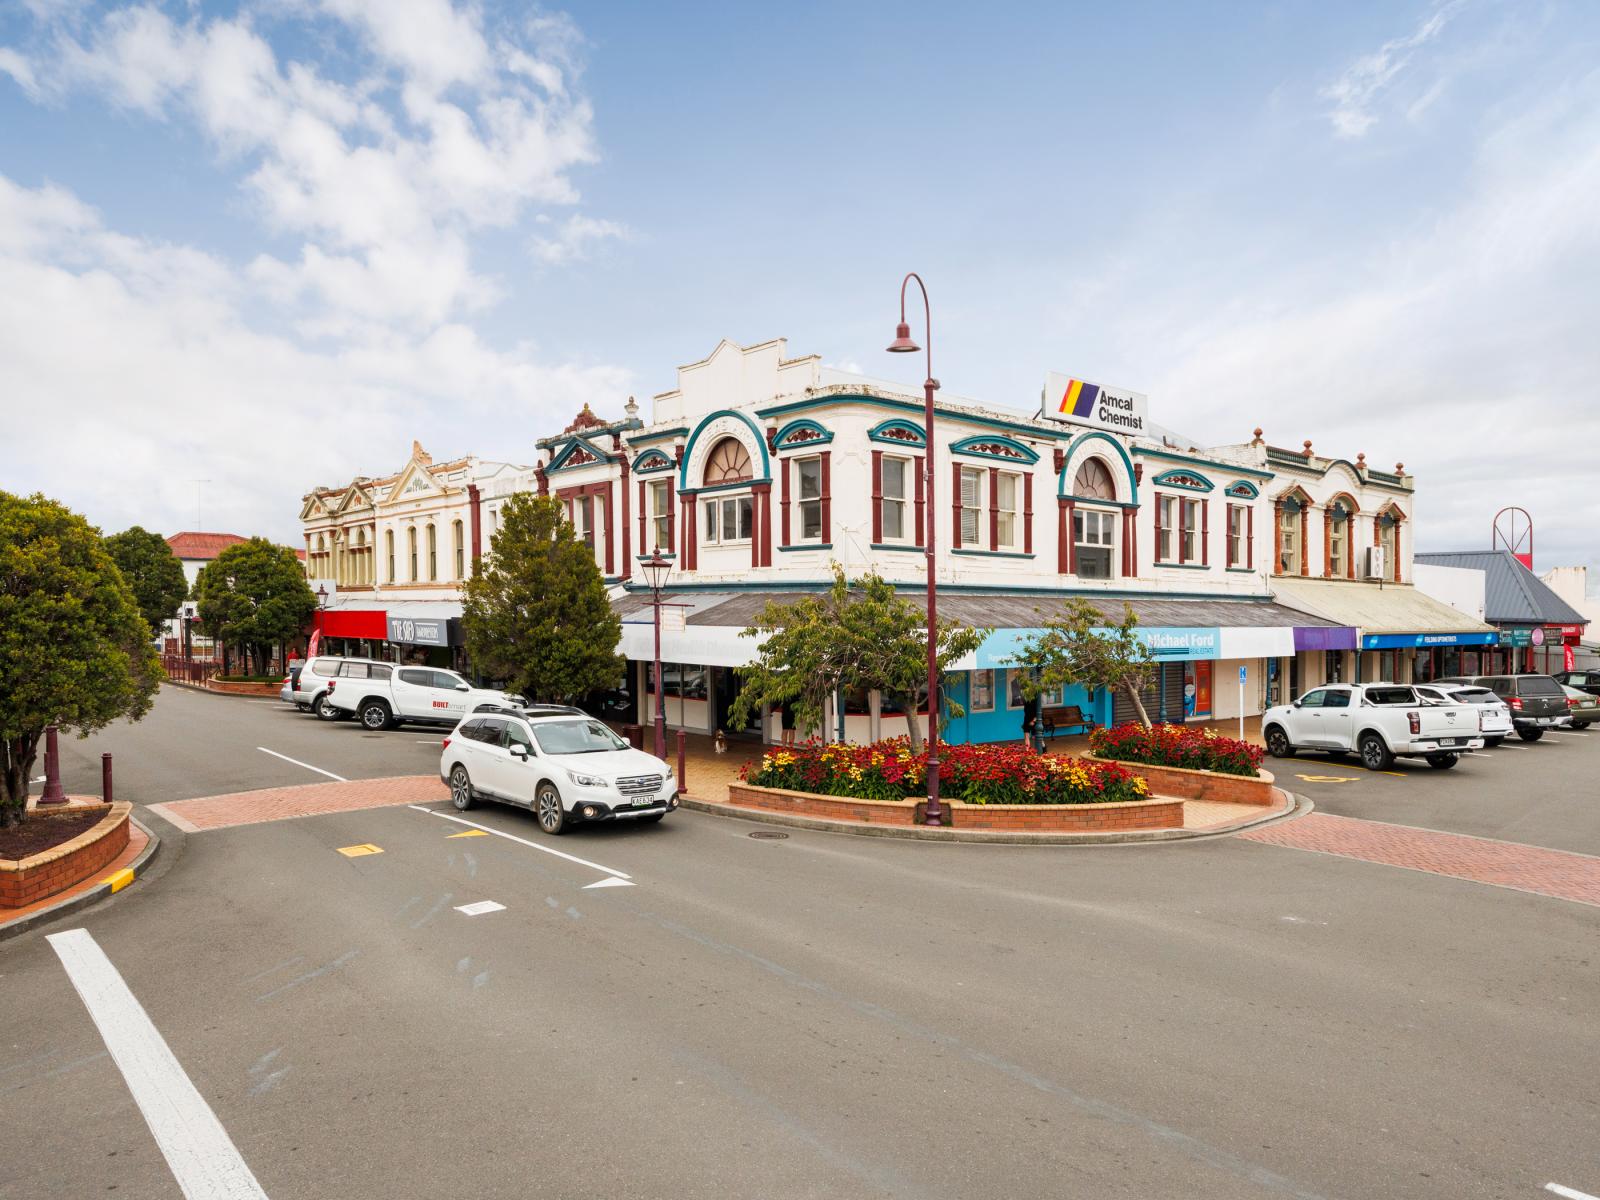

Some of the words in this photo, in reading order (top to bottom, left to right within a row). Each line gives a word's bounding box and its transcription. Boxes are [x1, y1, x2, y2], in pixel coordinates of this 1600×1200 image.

[1100, 390, 1133, 411] Amcal
[1099, 407, 1142, 430] Chemist
[391, 620, 403, 640] THE
[402, 620, 415, 641] SHED
[1147, 633, 1189, 648] Michael
[1191, 633, 1214, 647] Ford
